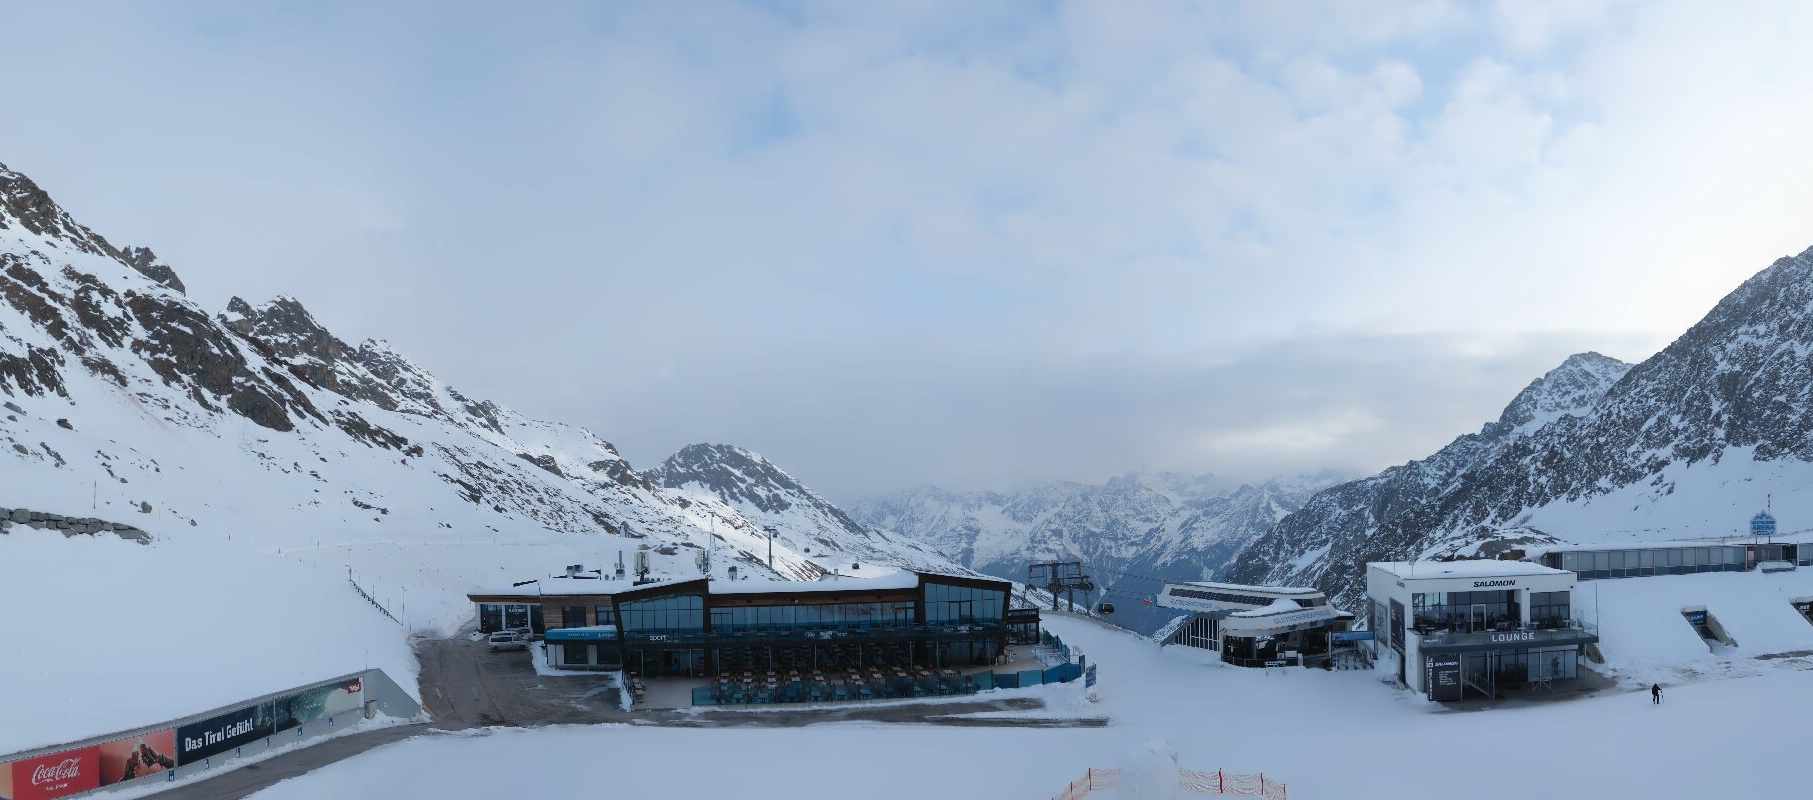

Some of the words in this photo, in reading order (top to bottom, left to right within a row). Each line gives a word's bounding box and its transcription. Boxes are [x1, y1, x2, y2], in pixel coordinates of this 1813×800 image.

[1473, 579, 1516, 588] SALOMON
[1492, 632, 1535, 642] LOUNGE
[185, 737, 203, 752] Das
[204, 726, 225, 746] Tirol
[226, 717, 254, 739] Gefühl
